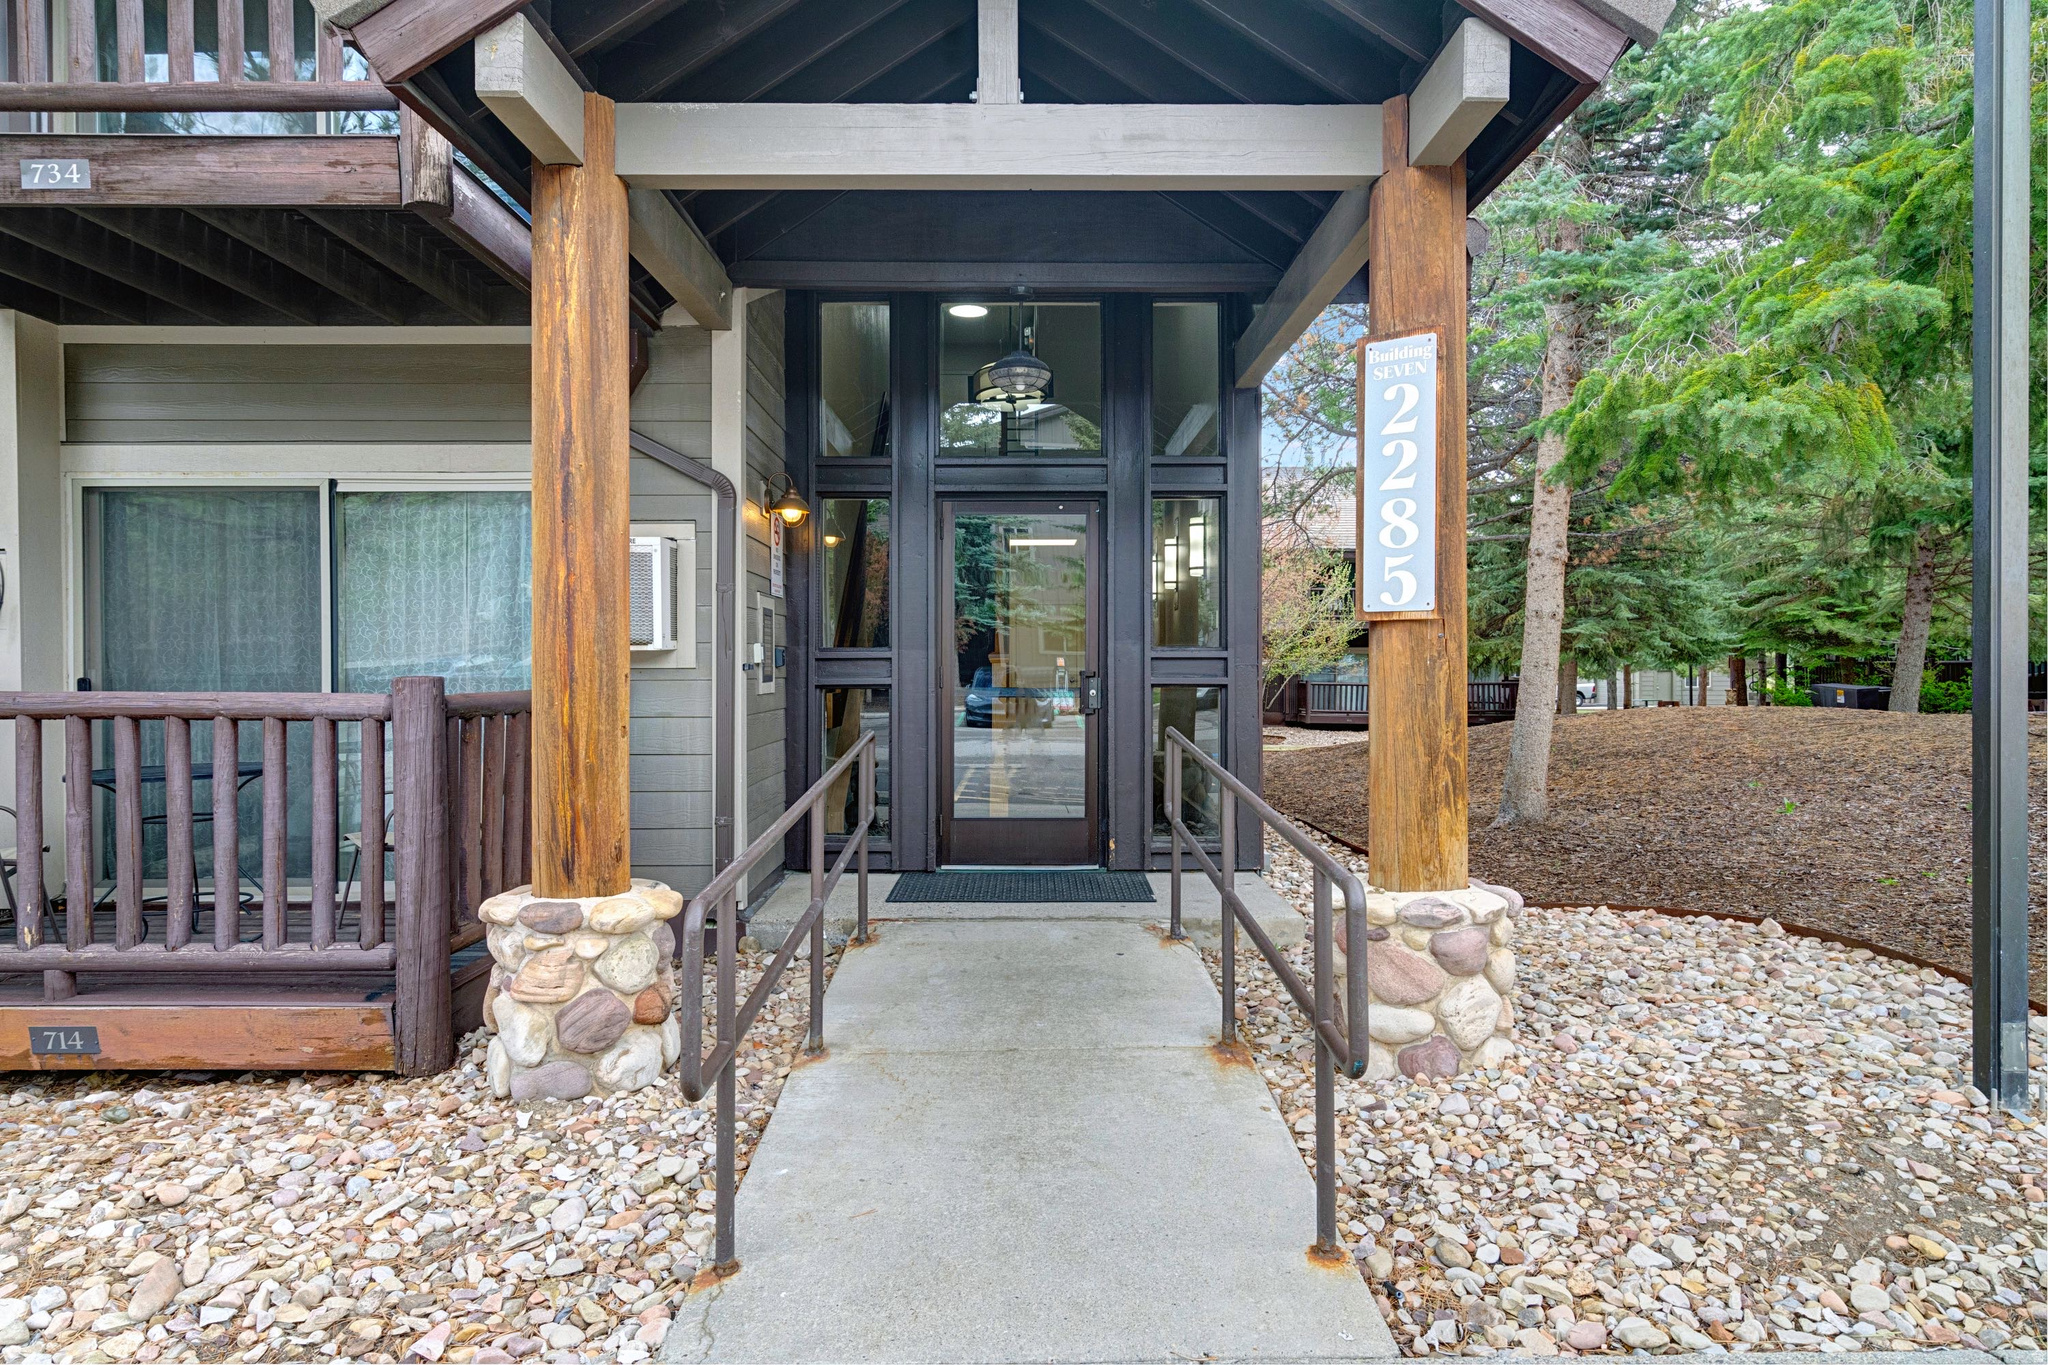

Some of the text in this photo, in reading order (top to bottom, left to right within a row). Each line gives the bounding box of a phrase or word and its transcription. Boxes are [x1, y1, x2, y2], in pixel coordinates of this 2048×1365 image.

[30, 163, 81, 184] 734
[1369, 345, 1433, 365] Building
[1373, 360, 1427, 381] SEVEN
[1378, 383, 1420, 607] 2285
[43, 1031, 84, 1050] 714
